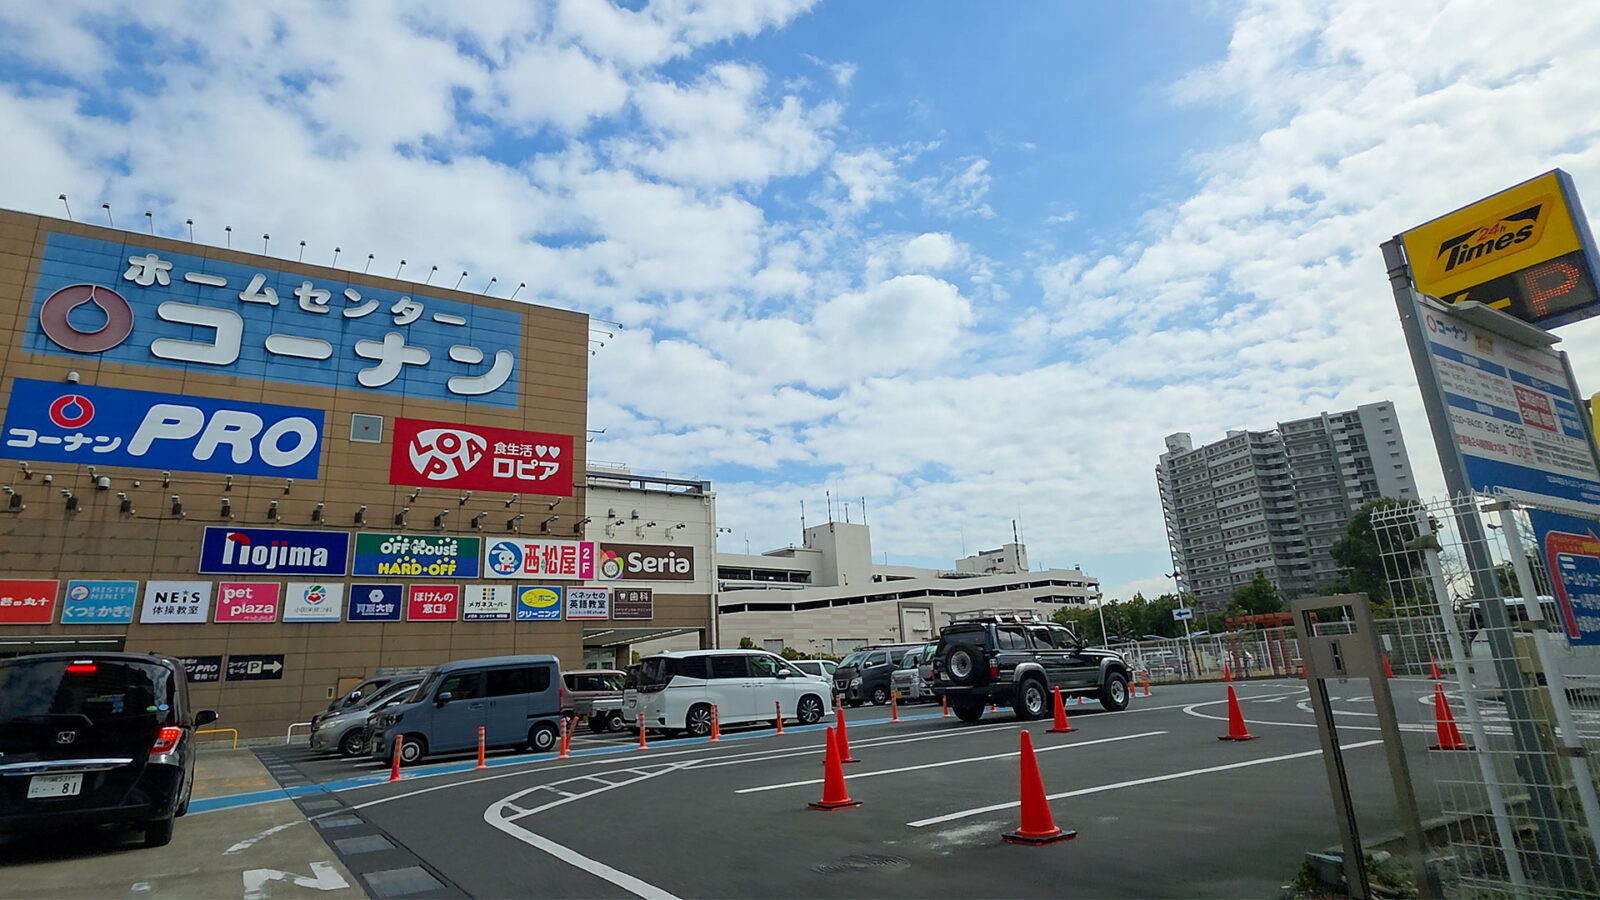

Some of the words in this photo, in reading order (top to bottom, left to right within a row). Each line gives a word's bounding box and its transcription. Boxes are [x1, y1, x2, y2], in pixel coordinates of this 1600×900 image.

[1443, 222, 1534, 273] Times
[122, 252, 467, 325] ホームセンター
[1524, 262, 1580, 318] P
[150, 300, 515, 395] コーナン
[6, 427, 122, 453] コーナン
[127, 403, 318, 467] PRO
[493, 441, 534, 458] 食生活
[493, 457, 560, 481] ロピア
[412, 539, 458, 556] HOUSE
[523, 544, 577, 574] 西松屋
[627, 551, 690, 573] Seria
[222, 587, 254, 604] pet
[413, 591, 454, 602] ほけんの
[569, 599, 606, 609] 英語教室
[570, 592, 606, 600] ベネッセの
[629, 592, 649, 602] 歯科
[152, 605, 199, 615] 体操教室
[230, 602, 274, 617] plaza
[518, 609, 560, 618] クリーニング
